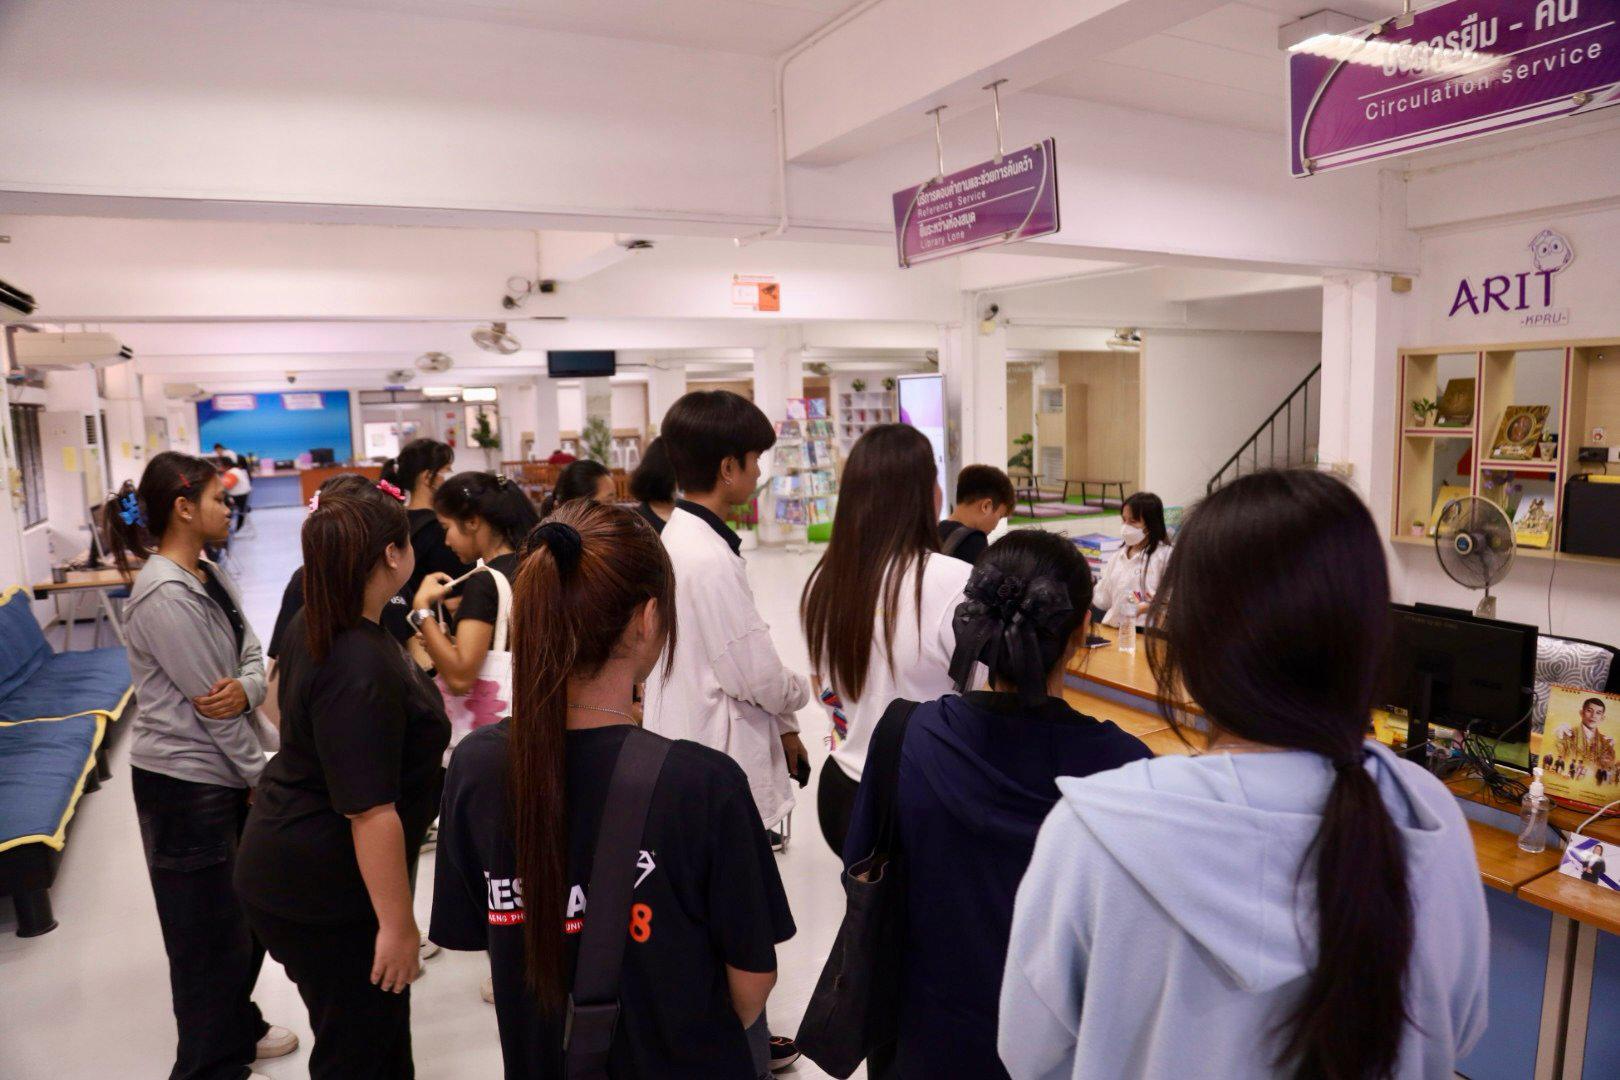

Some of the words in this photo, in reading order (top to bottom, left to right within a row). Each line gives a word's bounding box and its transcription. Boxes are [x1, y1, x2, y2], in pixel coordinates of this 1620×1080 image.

[1365, 75, 1491, 121] Circulation
[1502, 42, 1602, 83] service
[918, 200, 953, 219] Reference
[958, 189, 987, 205] Service
[920, 233, 946, 249] Library
[1449, 268, 1561, 317] ARIT
